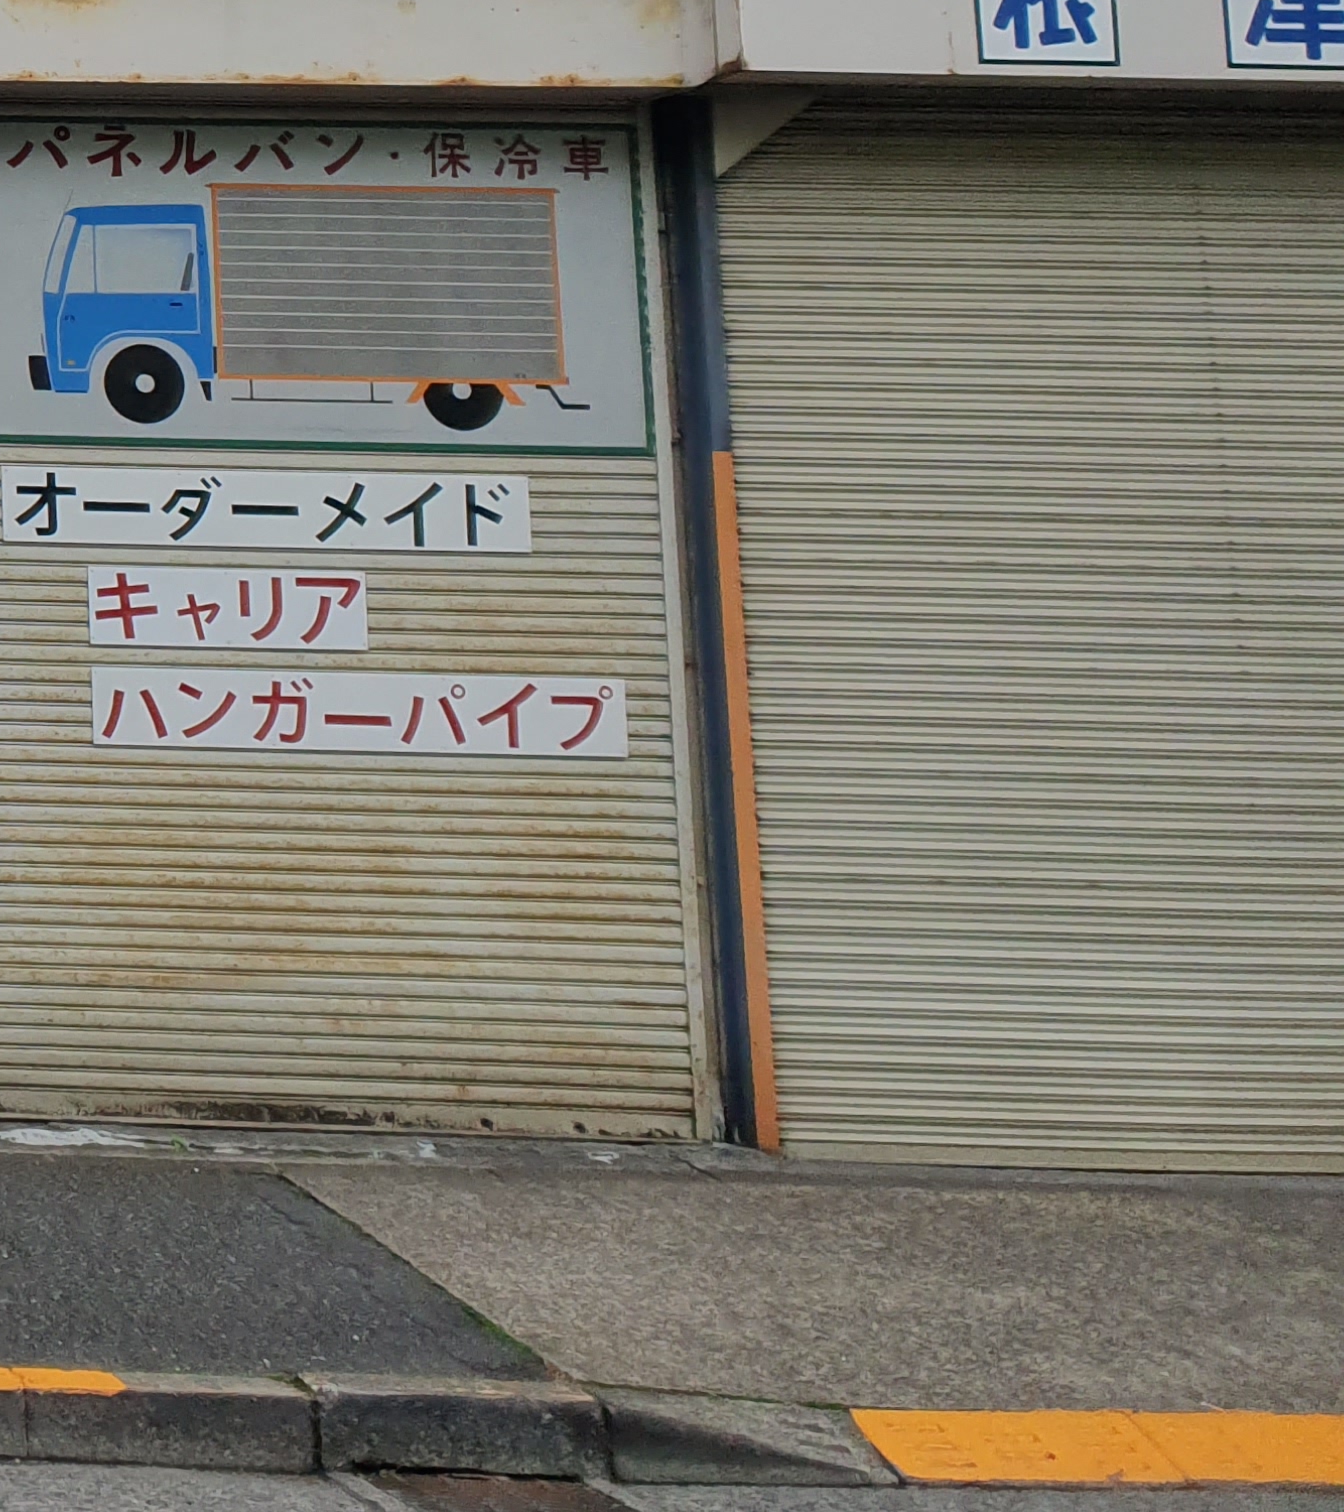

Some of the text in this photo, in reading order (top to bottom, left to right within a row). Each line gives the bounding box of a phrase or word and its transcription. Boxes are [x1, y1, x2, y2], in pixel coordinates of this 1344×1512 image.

[6, 124, 611, 182] パネルバン・保冷車
[13, 470, 511, 548] オーダーメイド
[93, 571, 362, 645] キャリア
[100, 676, 614, 751] ハンガーパイプ
